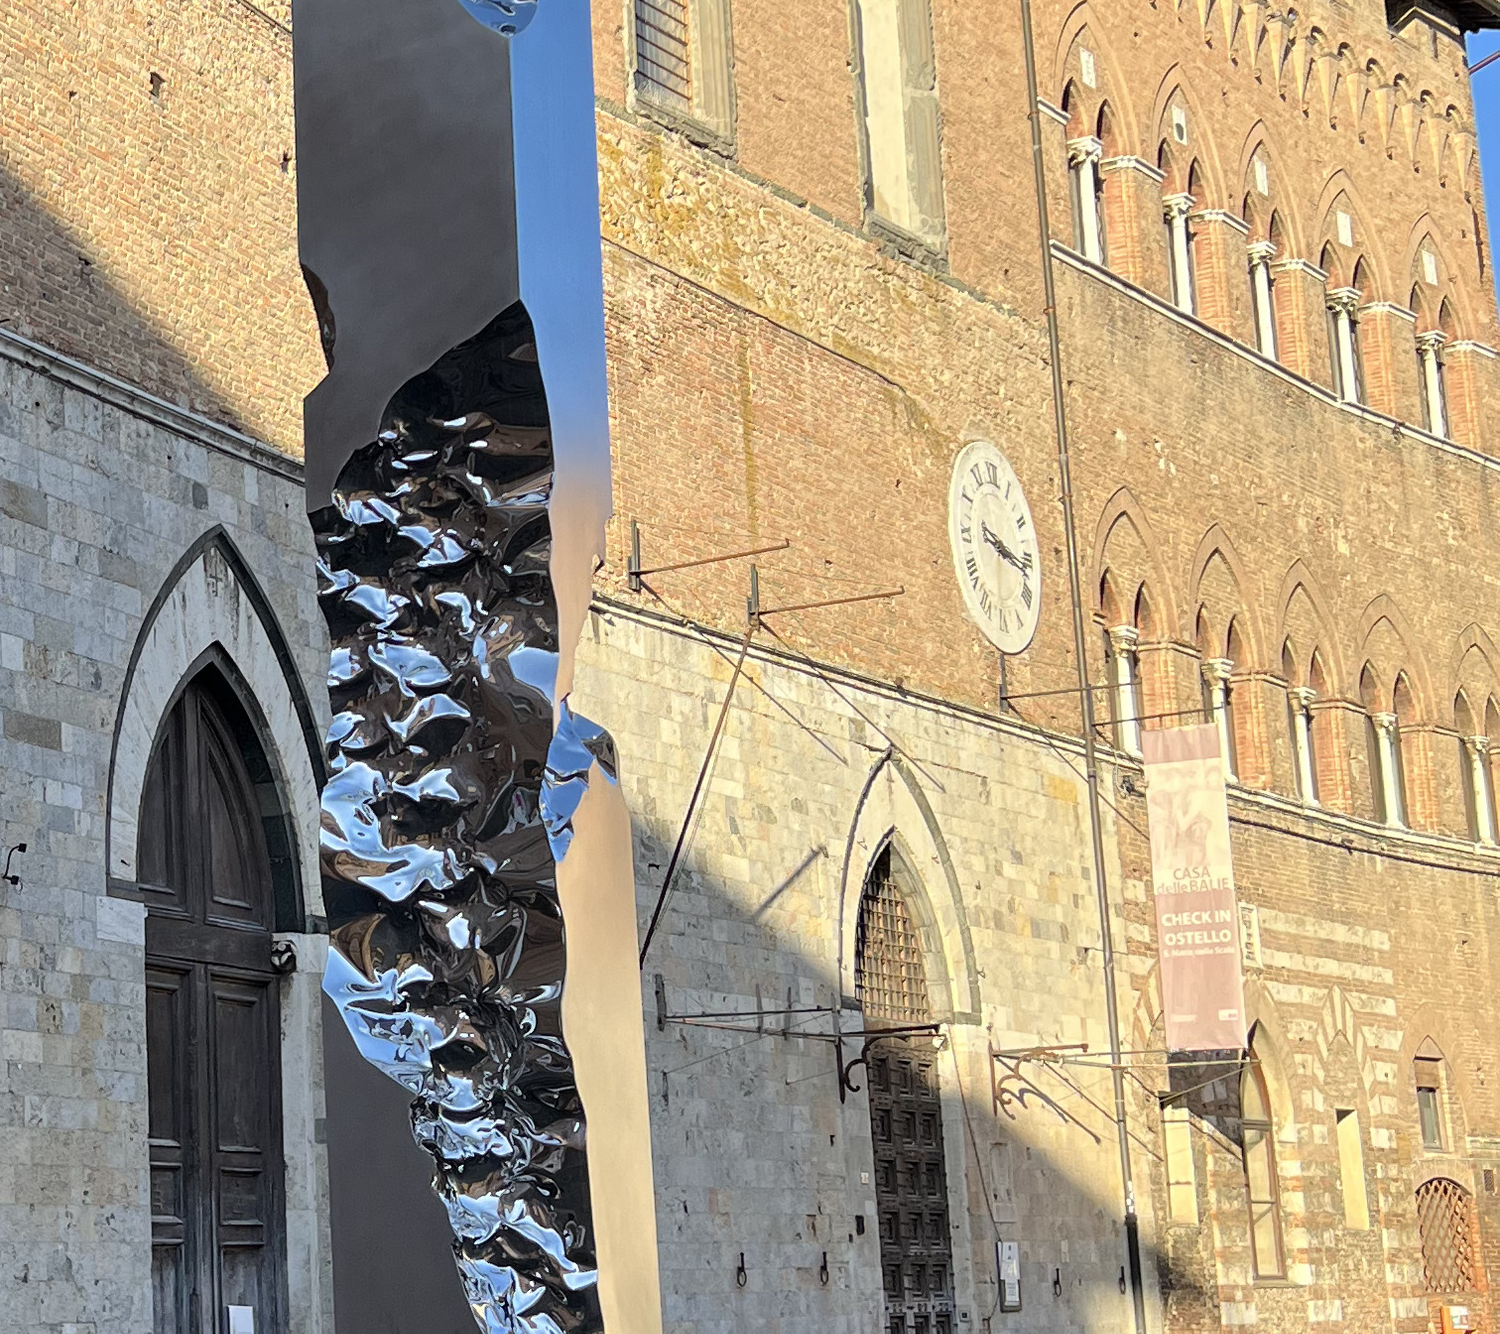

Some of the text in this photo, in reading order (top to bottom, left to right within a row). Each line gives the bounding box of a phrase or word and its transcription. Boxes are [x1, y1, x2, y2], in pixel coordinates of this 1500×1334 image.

[985, 460, 1000, 489] XII
[1016, 515, 1026, 529] II
[966, 557, 980, 591] VIII
[1173, 866, 1211, 880] CASA
[1156, 877, 1231, 895] delle BALIE
[1161, 909, 1231, 927] CHECK IN
[1164, 928, 1232, 947] OSTELLO
